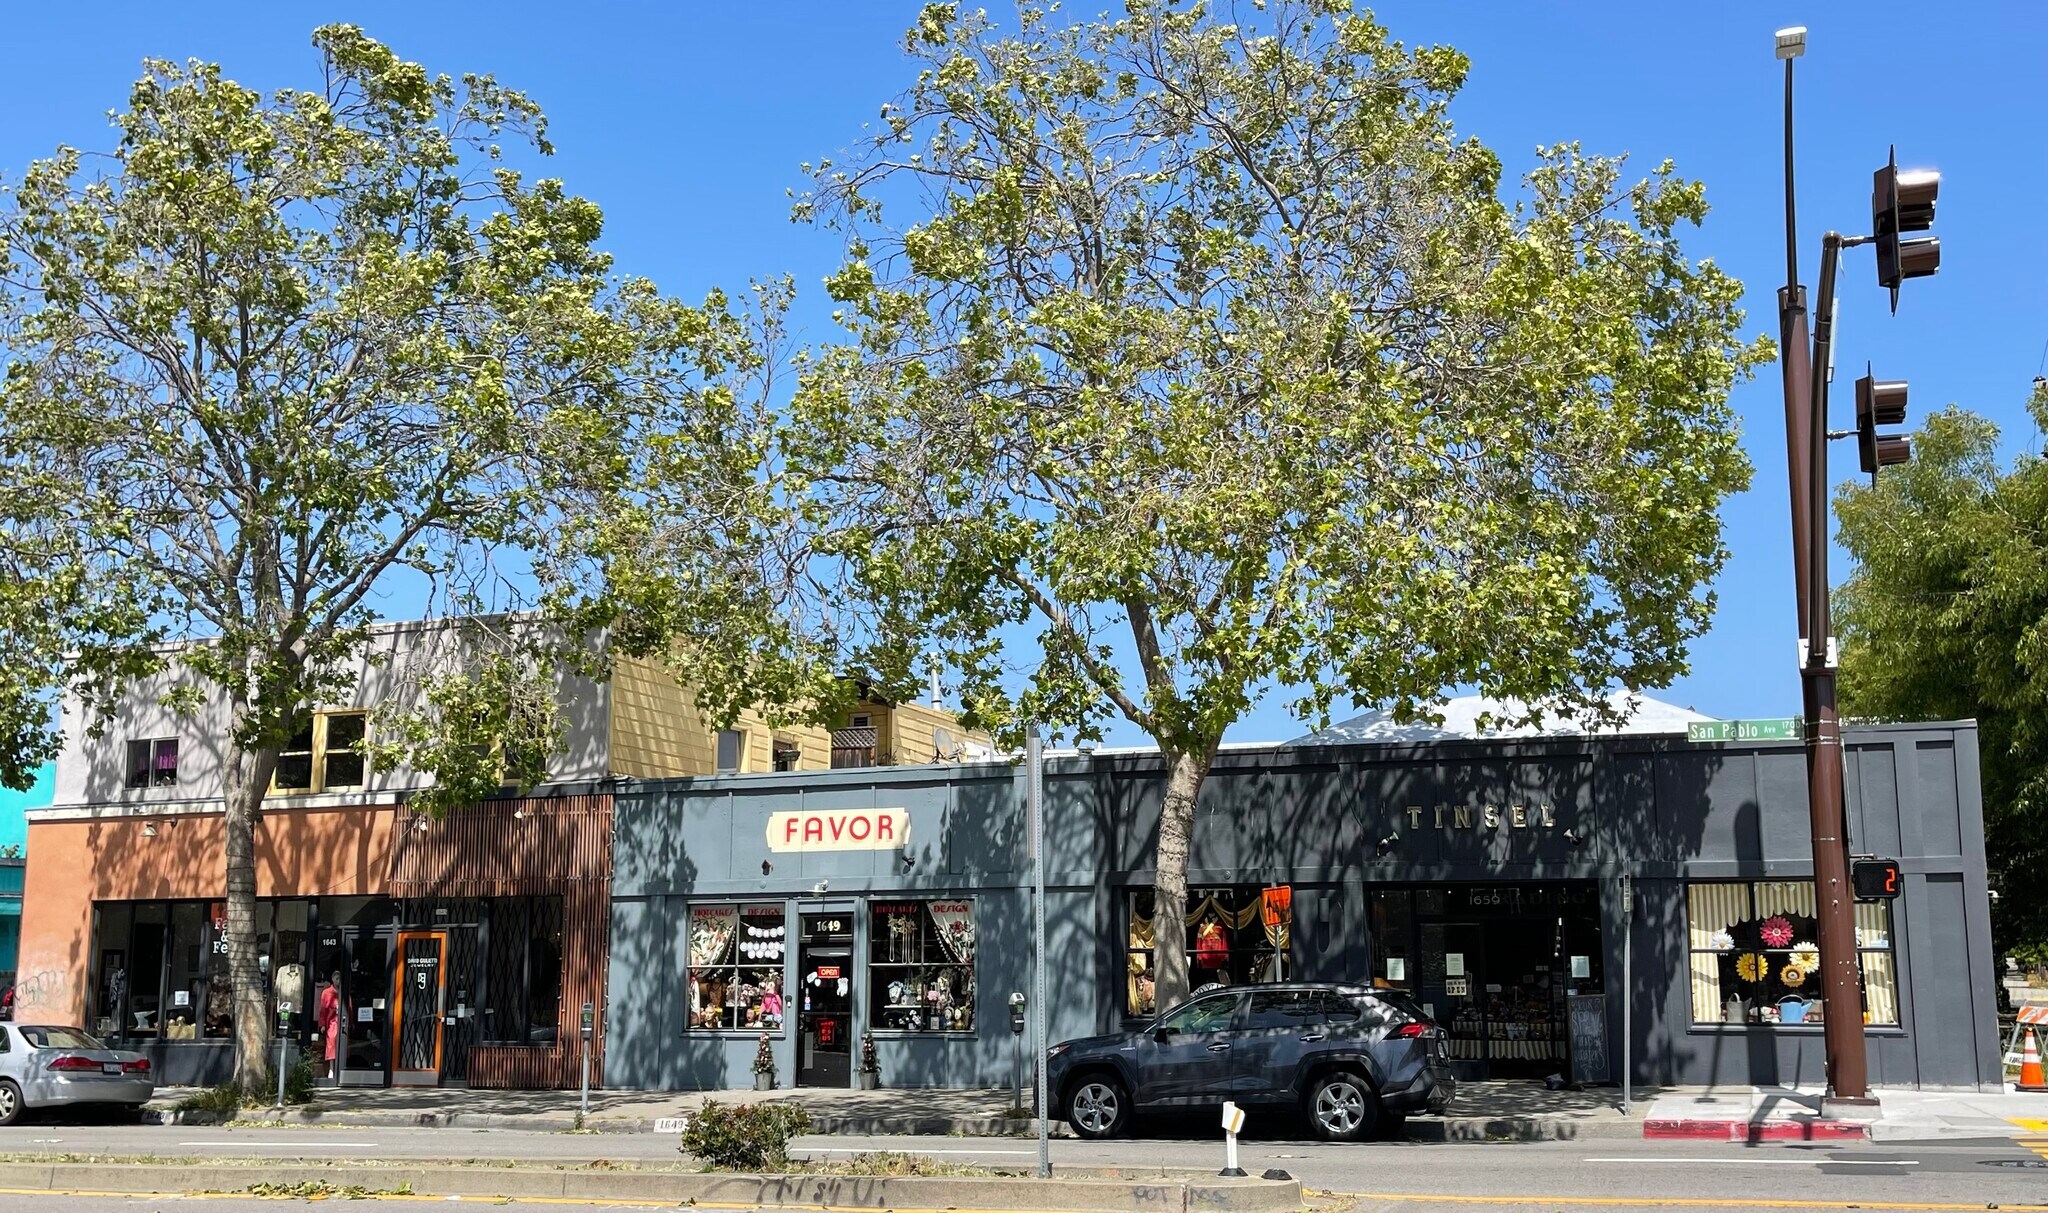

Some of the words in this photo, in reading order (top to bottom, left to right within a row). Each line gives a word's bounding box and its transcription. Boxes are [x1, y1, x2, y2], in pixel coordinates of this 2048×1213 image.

[1691, 724, 1714, 739] San
[1722, 722, 1758, 739] Pablo
[1763, 725, 1776, 734] Ave
[1406, 803, 1557, 830] TINSEL
[786, 814, 893, 842] FAVOR
[1886, 868, 1896, 892] 2
[1470, 895, 1500, 905] 1659
[747, 907, 780, 916] DESIGN
[934, 904, 969, 913] DESIGN
[817, 920, 841, 932] 1649
[213, 941, 228, 953] Fe
[820, 968, 838, 976] OPEN
